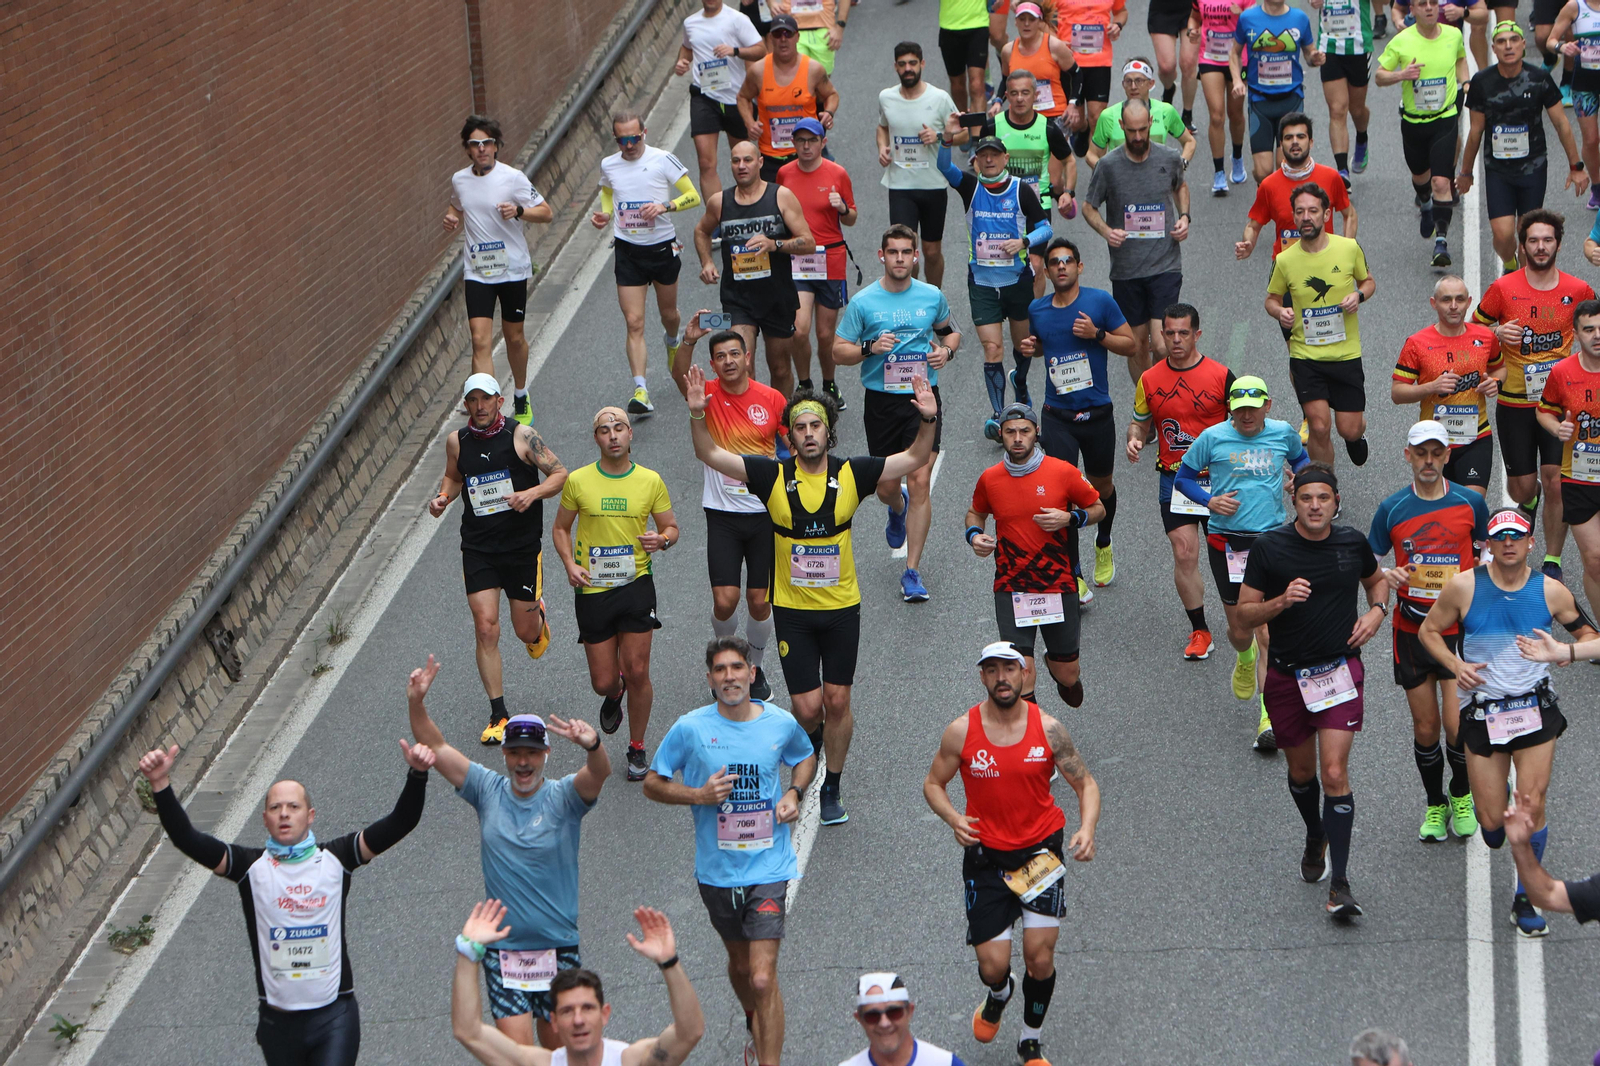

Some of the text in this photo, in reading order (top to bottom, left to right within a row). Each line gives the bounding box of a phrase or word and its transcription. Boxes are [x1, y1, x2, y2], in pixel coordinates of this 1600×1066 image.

[725, 224, 744, 236] JUST
[1314, 306, 1338, 316] ZURICH
[898, 354, 922, 362] ZURICH
[1060, 353, 1083, 364] ZURICH
[1061, 367, 1076, 376] 8771
[481, 472, 505, 482] ZURICH
[483, 487, 498, 496] 8431
[1426, 556, 1454, 564] ZURICH
[1030, 597, 1046, 606] 7223
[1317, 677, 1334, 688] 7371
[1505, 716, 1523, 725] 7395
[737, 764, 759, 776] REAL
[729, 791, 760, 801] BEGINS
[737, 803, 766, 812] ZURICH
[736, 820, 755, 829] 7069
[286, 884, 312, 895] edp
[289, 927, 321, 938] ZURICH
[288, 946, 313, 956] 10472
